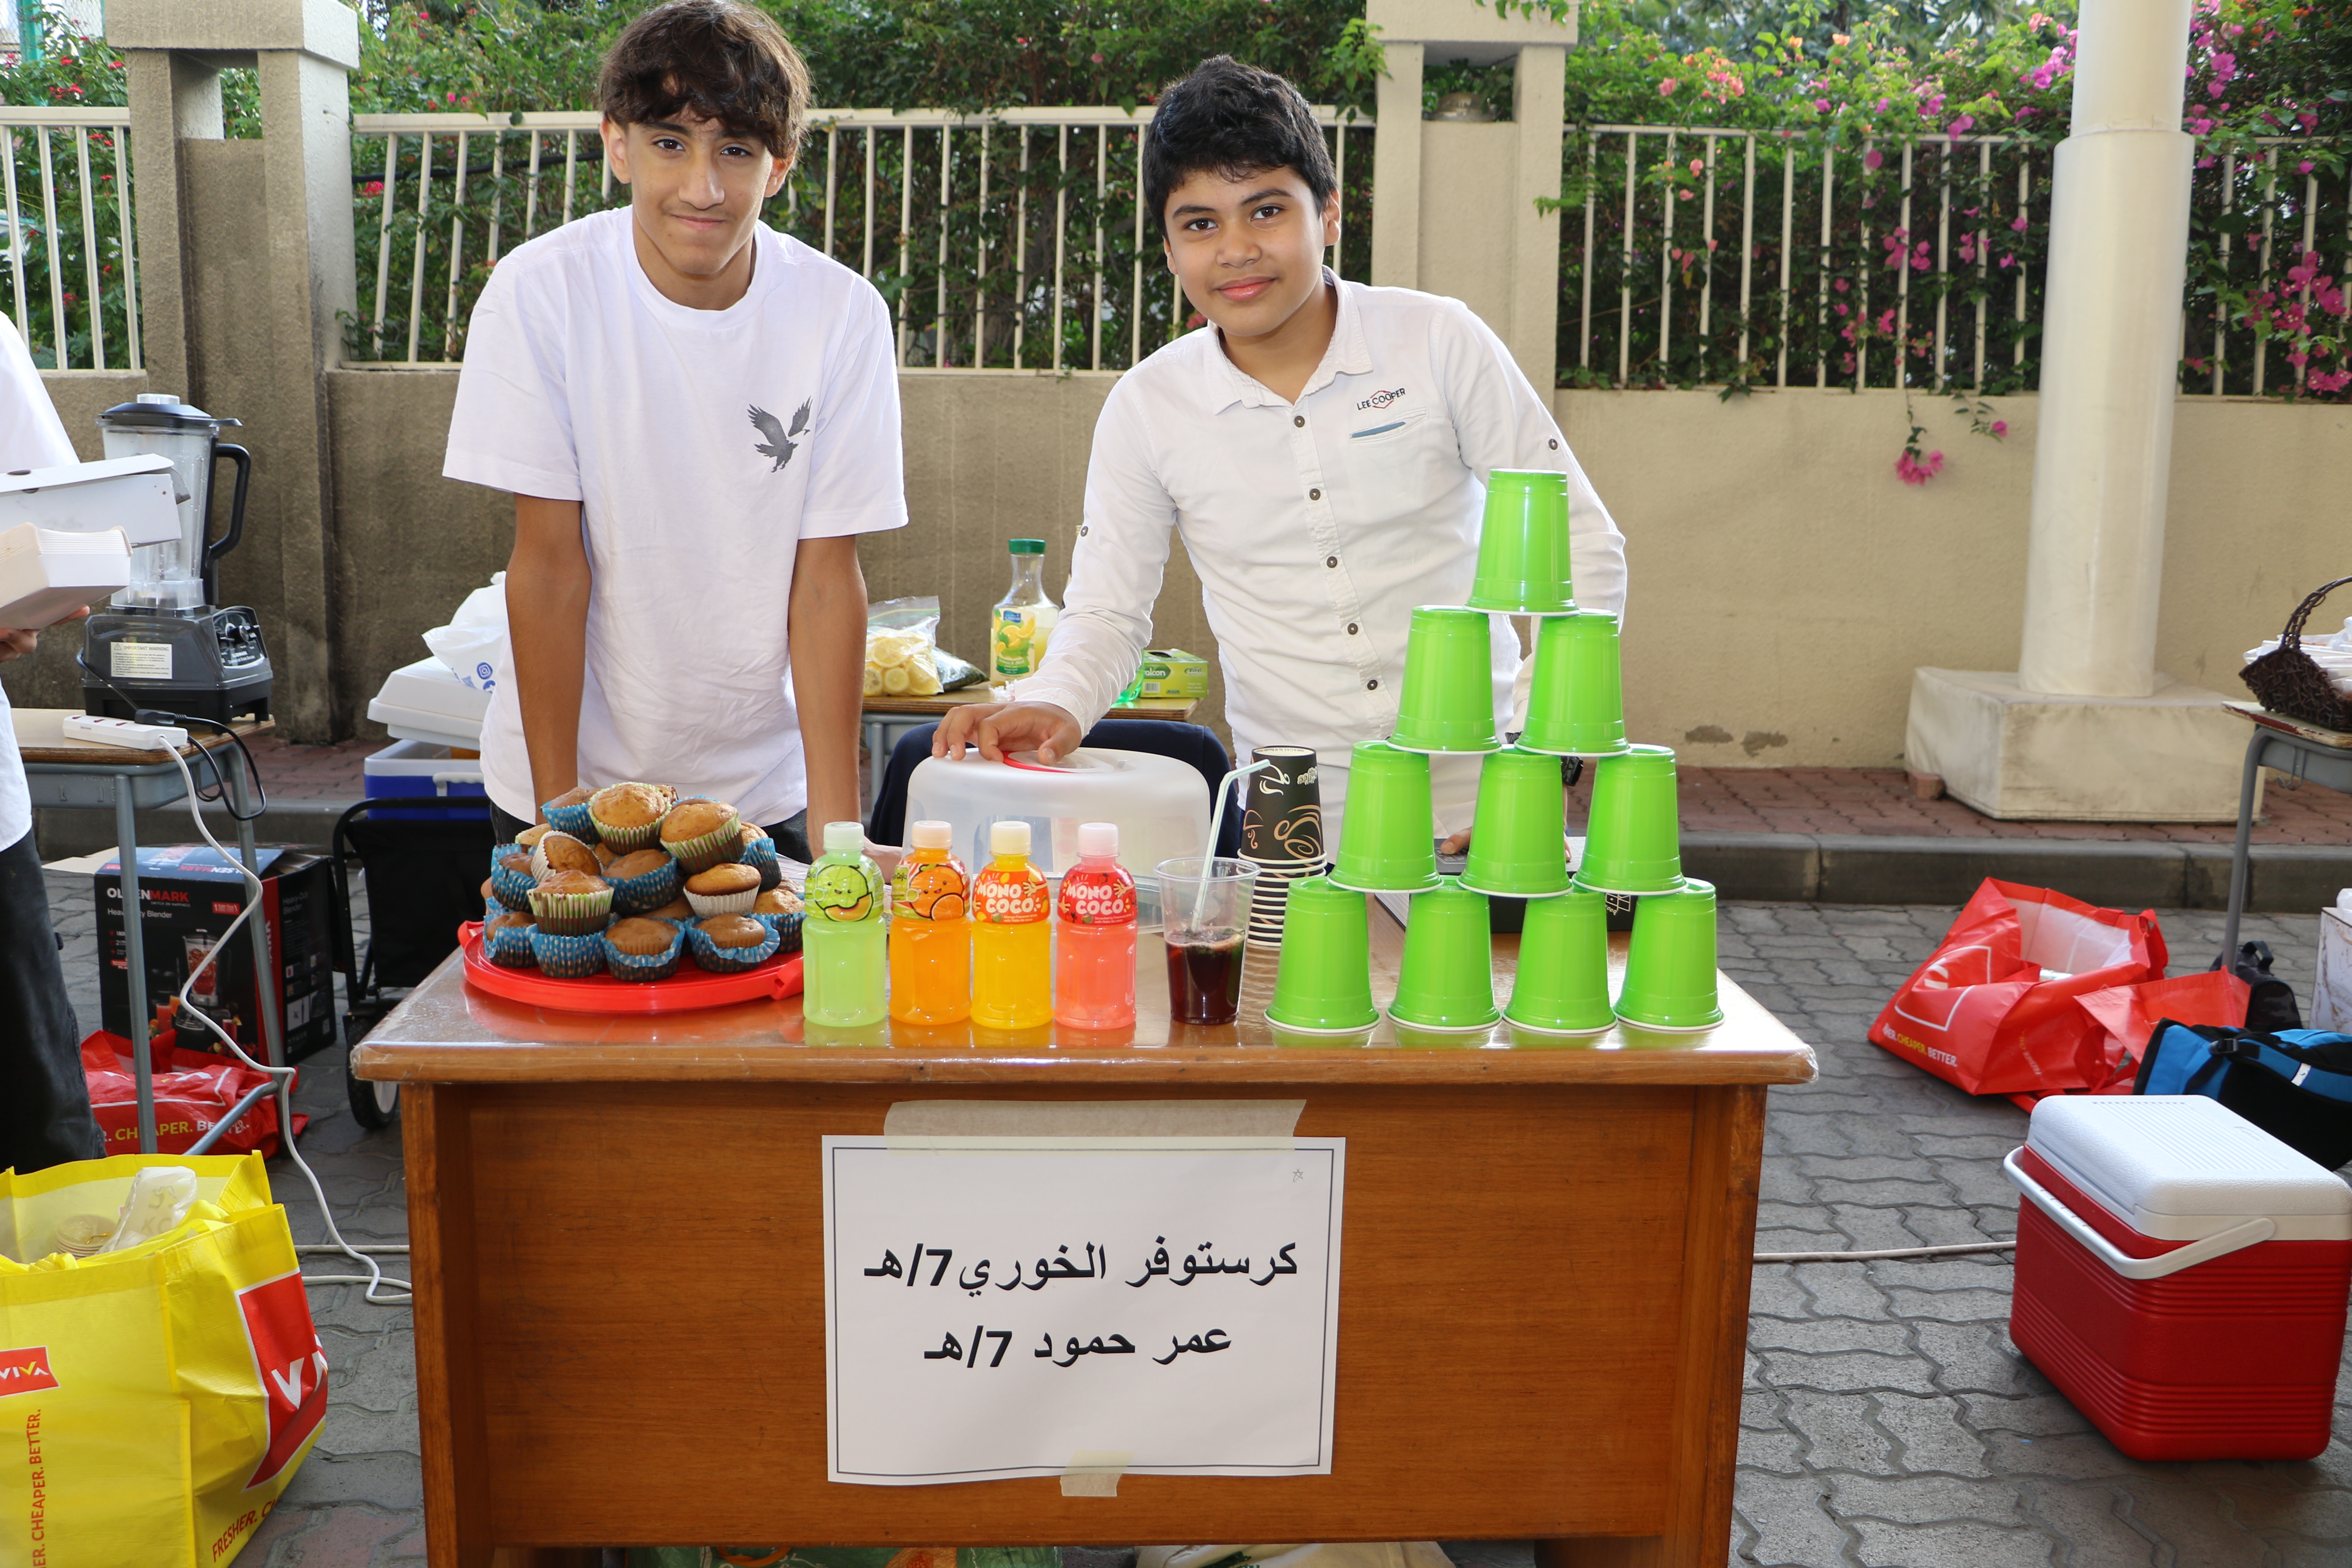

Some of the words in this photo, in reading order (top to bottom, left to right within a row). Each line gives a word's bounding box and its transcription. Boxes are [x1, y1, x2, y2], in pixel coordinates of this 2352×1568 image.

[1357, 399, 1372, 410] LEE
[1372, 388, 1406, 405] COOPER
[1145, 668, 1166, 676] alcon
[107, 888, 190, 902] OLNMARK
[977, 882, 1022, 898] MONO
[1066, 883, 1112, 900] MONO
[147, 910, 173, 918] Blender
[986, 897, 1034, 914] COCO
[1075, 899, 1124, 915] COCO
[1927, 1047, 1958, 1067] BETTER.
[115, 1121, 193, 1140] CHPER.
[1125, 1236, 1297, 1288] كرستوفر
[1034, 1332, 1136, 1368] حمود
[1153, 1329, 1231, 1365] عمر
[26, 1409, 42, 1465] BETTER.
[31, 1467, 46, 1541] CHEAPER.
[212, 1510, 257, 1563] FRESHER.
